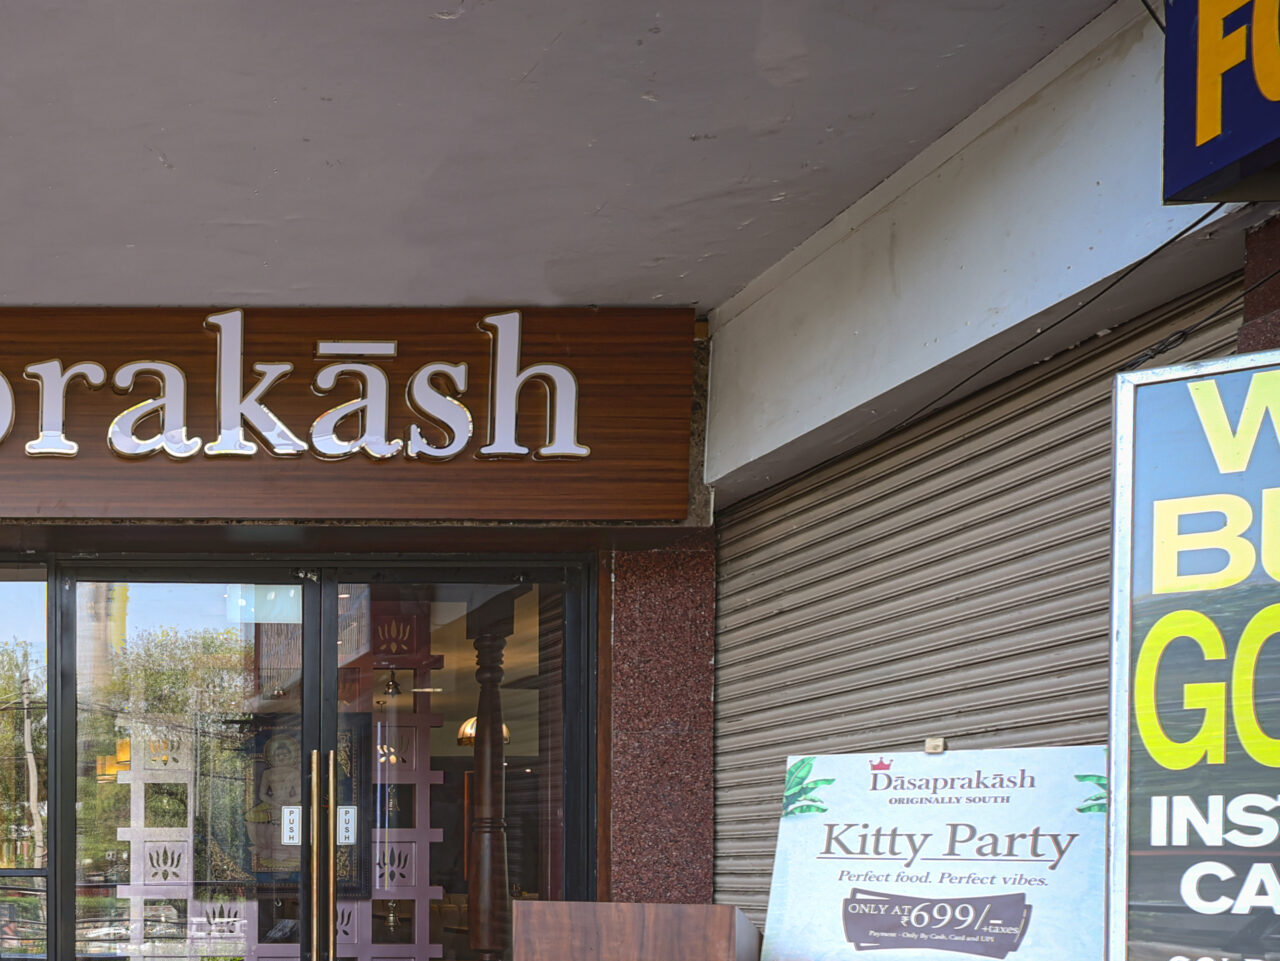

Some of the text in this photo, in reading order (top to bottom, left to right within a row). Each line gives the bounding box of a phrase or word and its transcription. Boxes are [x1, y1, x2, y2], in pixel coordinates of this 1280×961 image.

[1152, 488, 1280, 594] B
[869, 769, 1036, 794] Dāsaprakāsh
[889, 796, 963, 805] ORIGINALLY
[1150, 793, 1280, 847] INS
[820, 823, 1079, 870] Kitty Party
[838, 870, 1049, 887] Perfect food. Perfect vibes.
[848, 903, 912, 915] ONLY AT
[869, 930, 896, 938] Payment
[902, 932, 918, 940] Only
[981, 925, 1020, 934] +taxes
